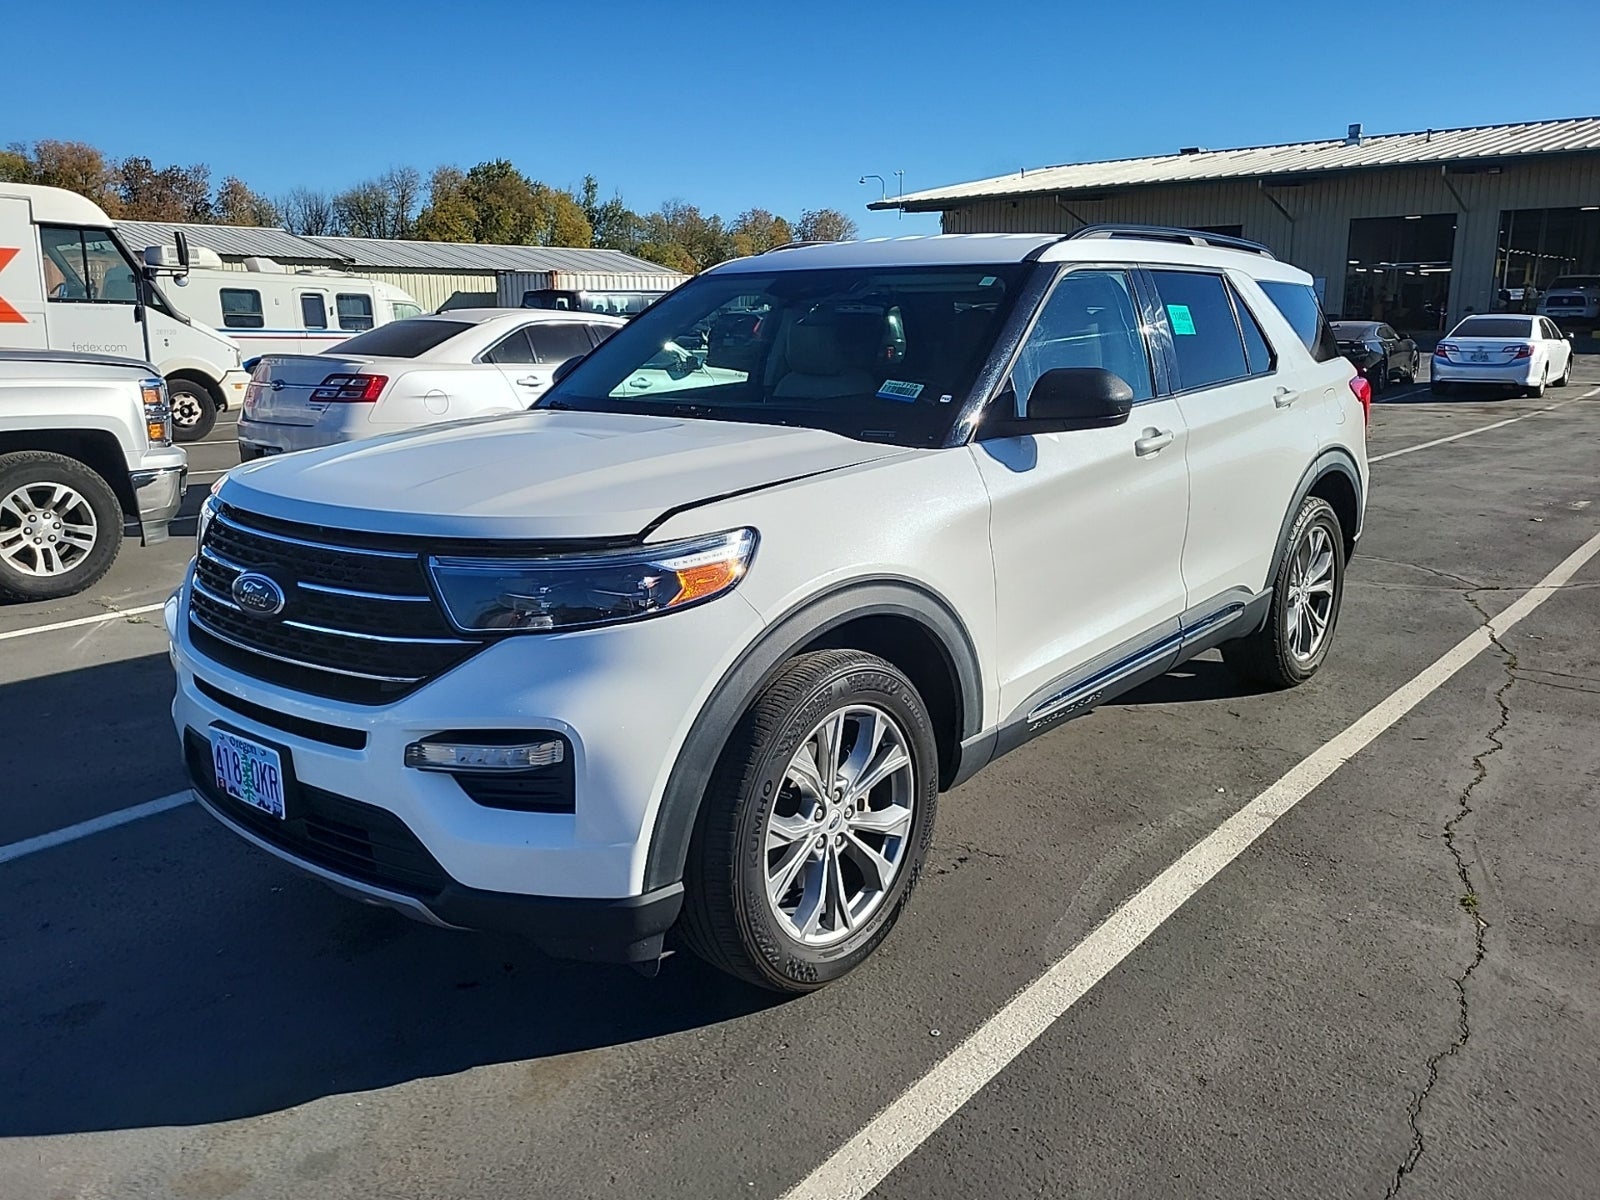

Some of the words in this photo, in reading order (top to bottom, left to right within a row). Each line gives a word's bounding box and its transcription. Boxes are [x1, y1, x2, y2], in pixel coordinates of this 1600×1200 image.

[72, 342, 128, 352] fedex.com
[240, 580, 270, 608] Ford
[229, 736, 257, 756] Oregon
[749, 779, 773, 869] KUMHO
